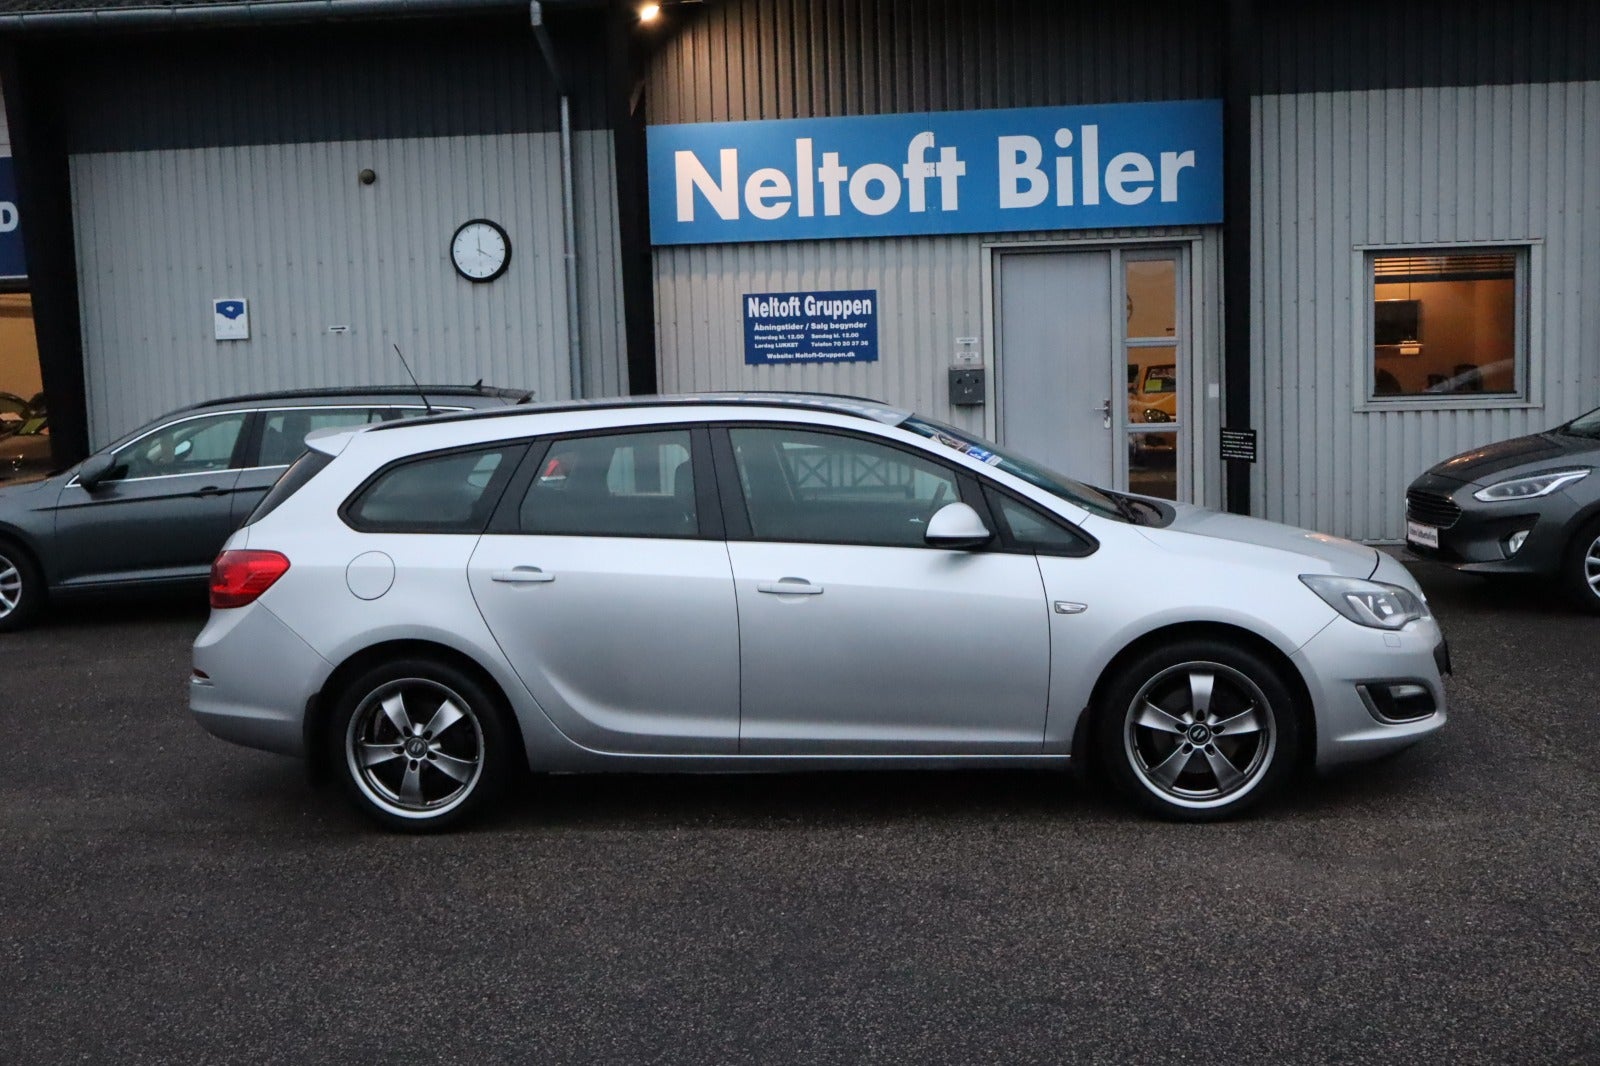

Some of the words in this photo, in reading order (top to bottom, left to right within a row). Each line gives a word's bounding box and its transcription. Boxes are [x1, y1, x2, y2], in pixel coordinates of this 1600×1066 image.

[675, 131, 966, 223] Neltoft
[998, 124, 1196, 210] Biler
[748, 296, 801, 317] Neltoft
[804, 295, 872, 320] Gruppen
[754, 322, 804, 331] Åbningstider
[811, 322, 829, 330] Salg
[829, 321, 868, 330] begynder
